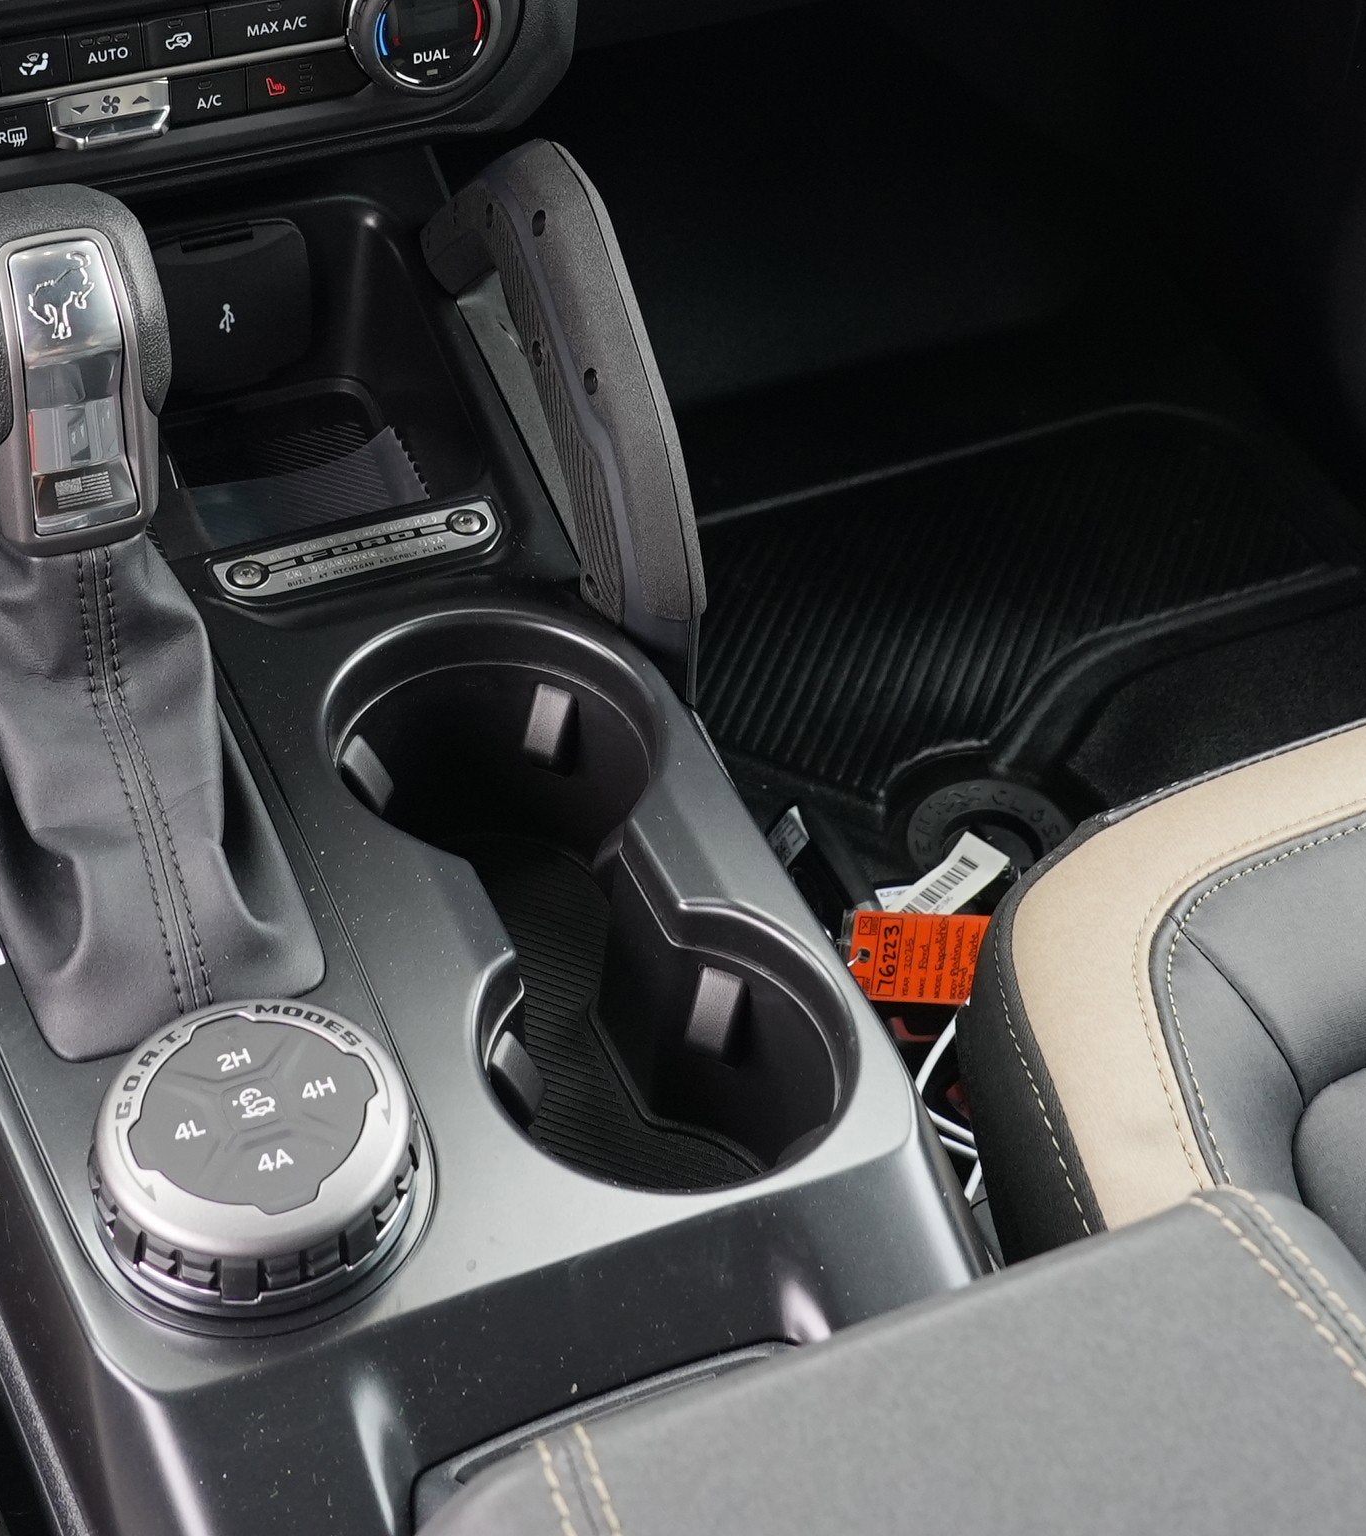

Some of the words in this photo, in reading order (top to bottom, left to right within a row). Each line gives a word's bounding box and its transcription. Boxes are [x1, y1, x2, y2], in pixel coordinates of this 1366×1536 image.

[247, 21, 279, 38] MAX
[282, 15, 309, 33] A/C
[87, 46, 130, 64] AUTO
[412, 47, 451, 65] DUAL
[196, 93, 223, 110] A/C
[287, 576, 314, 588] BUILT
[333, 561, 375, 576] MICHIGAN
[379, 550, 418, 565] ASSEMBLY
[422, 544, 448, 555] PLANT
[875, 924, 901, 994] 76223
[114, 1029, 183, 1121] G.O.A.T.
[254, 1003, 363, 1048] MODES
[216, 1047, 253, 1073] 2H
[301, 1076, 337, 1100] 4H
[174, 1120, 207, 1142] 4L
[257, 1148, 294, 1173] 4A
